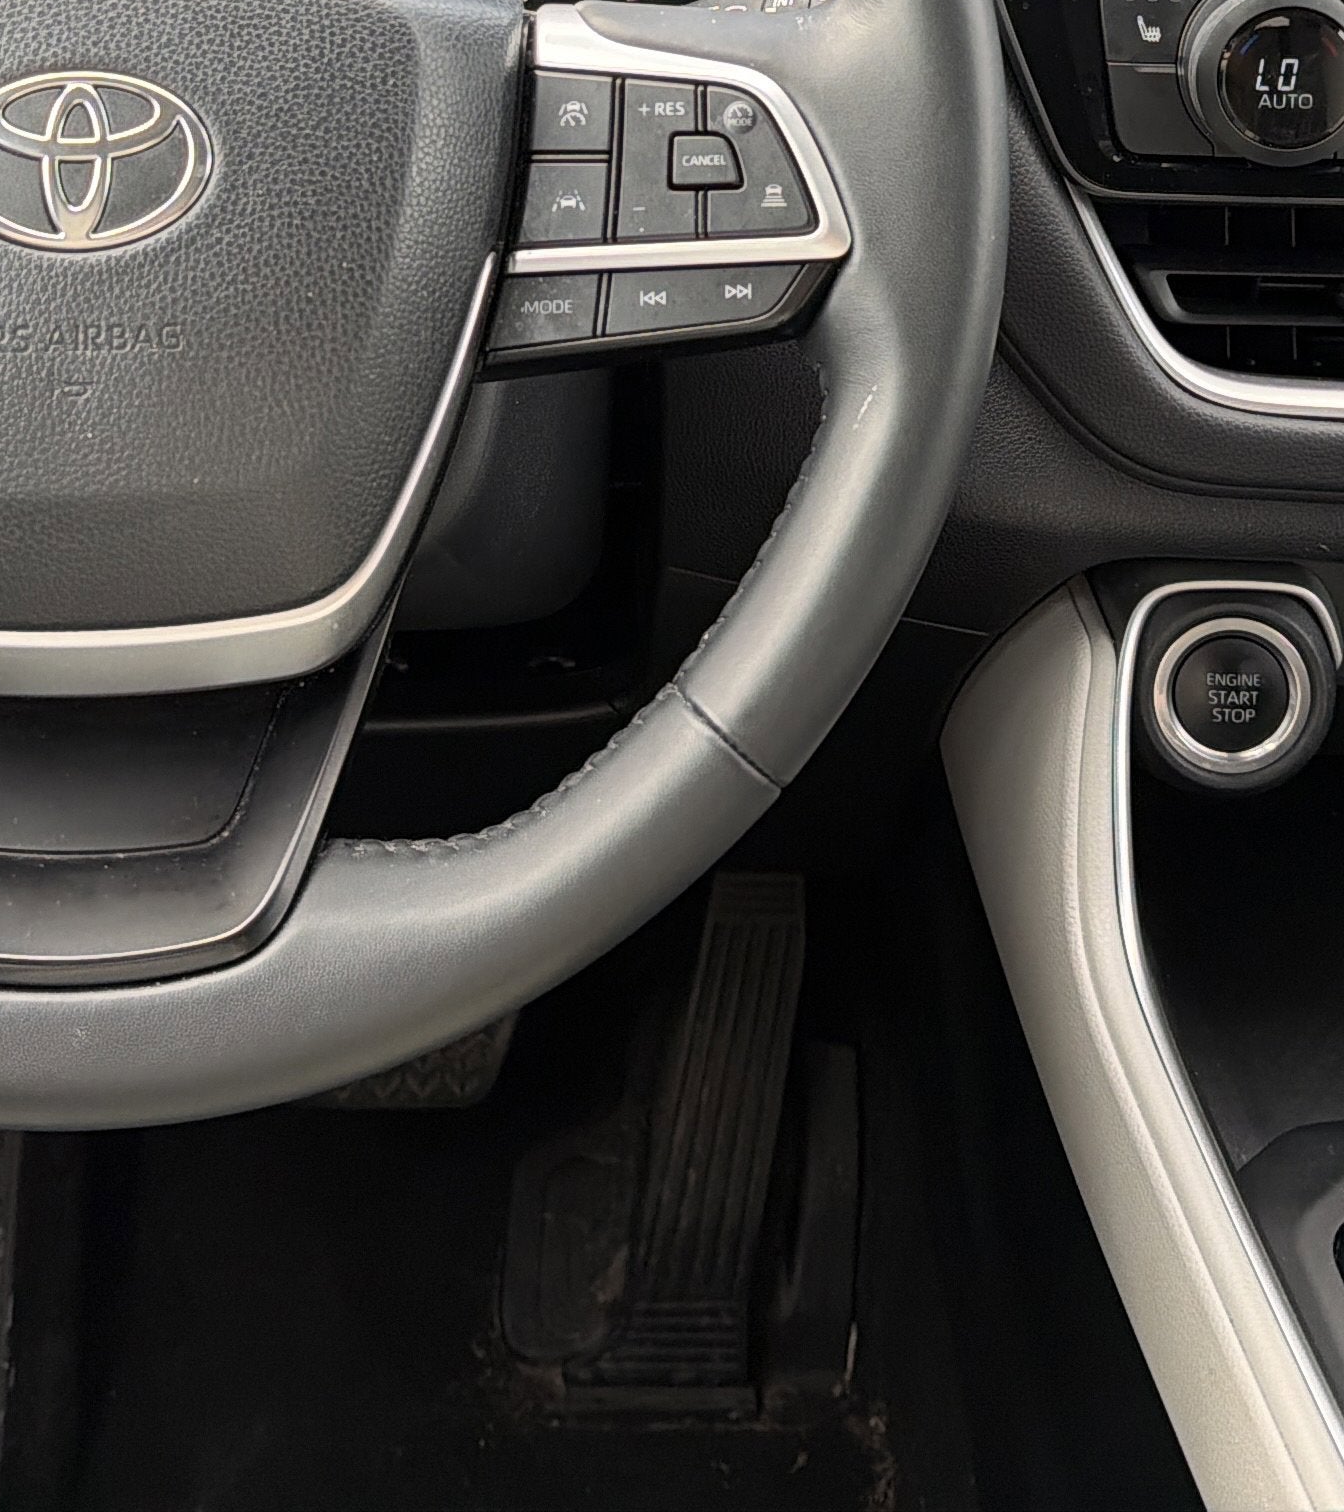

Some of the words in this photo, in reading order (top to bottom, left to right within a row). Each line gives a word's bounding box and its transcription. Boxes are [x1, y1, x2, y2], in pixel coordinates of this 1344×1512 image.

[1255, 58, 1300, 92] LO
[1257, 92, 1314, 110] AUTO
[726, 116, 753, 128] MODE
[681, 153, 727, 167] CANCEL
[523, 299, 574, 315] MODE
[45, 323, 184, 355] AIRBAG
[1205, 672, 1262, 687] ENGINE
[1207, 690, 1259, 705] START
[1211, 708, 1256, 724] STOP
